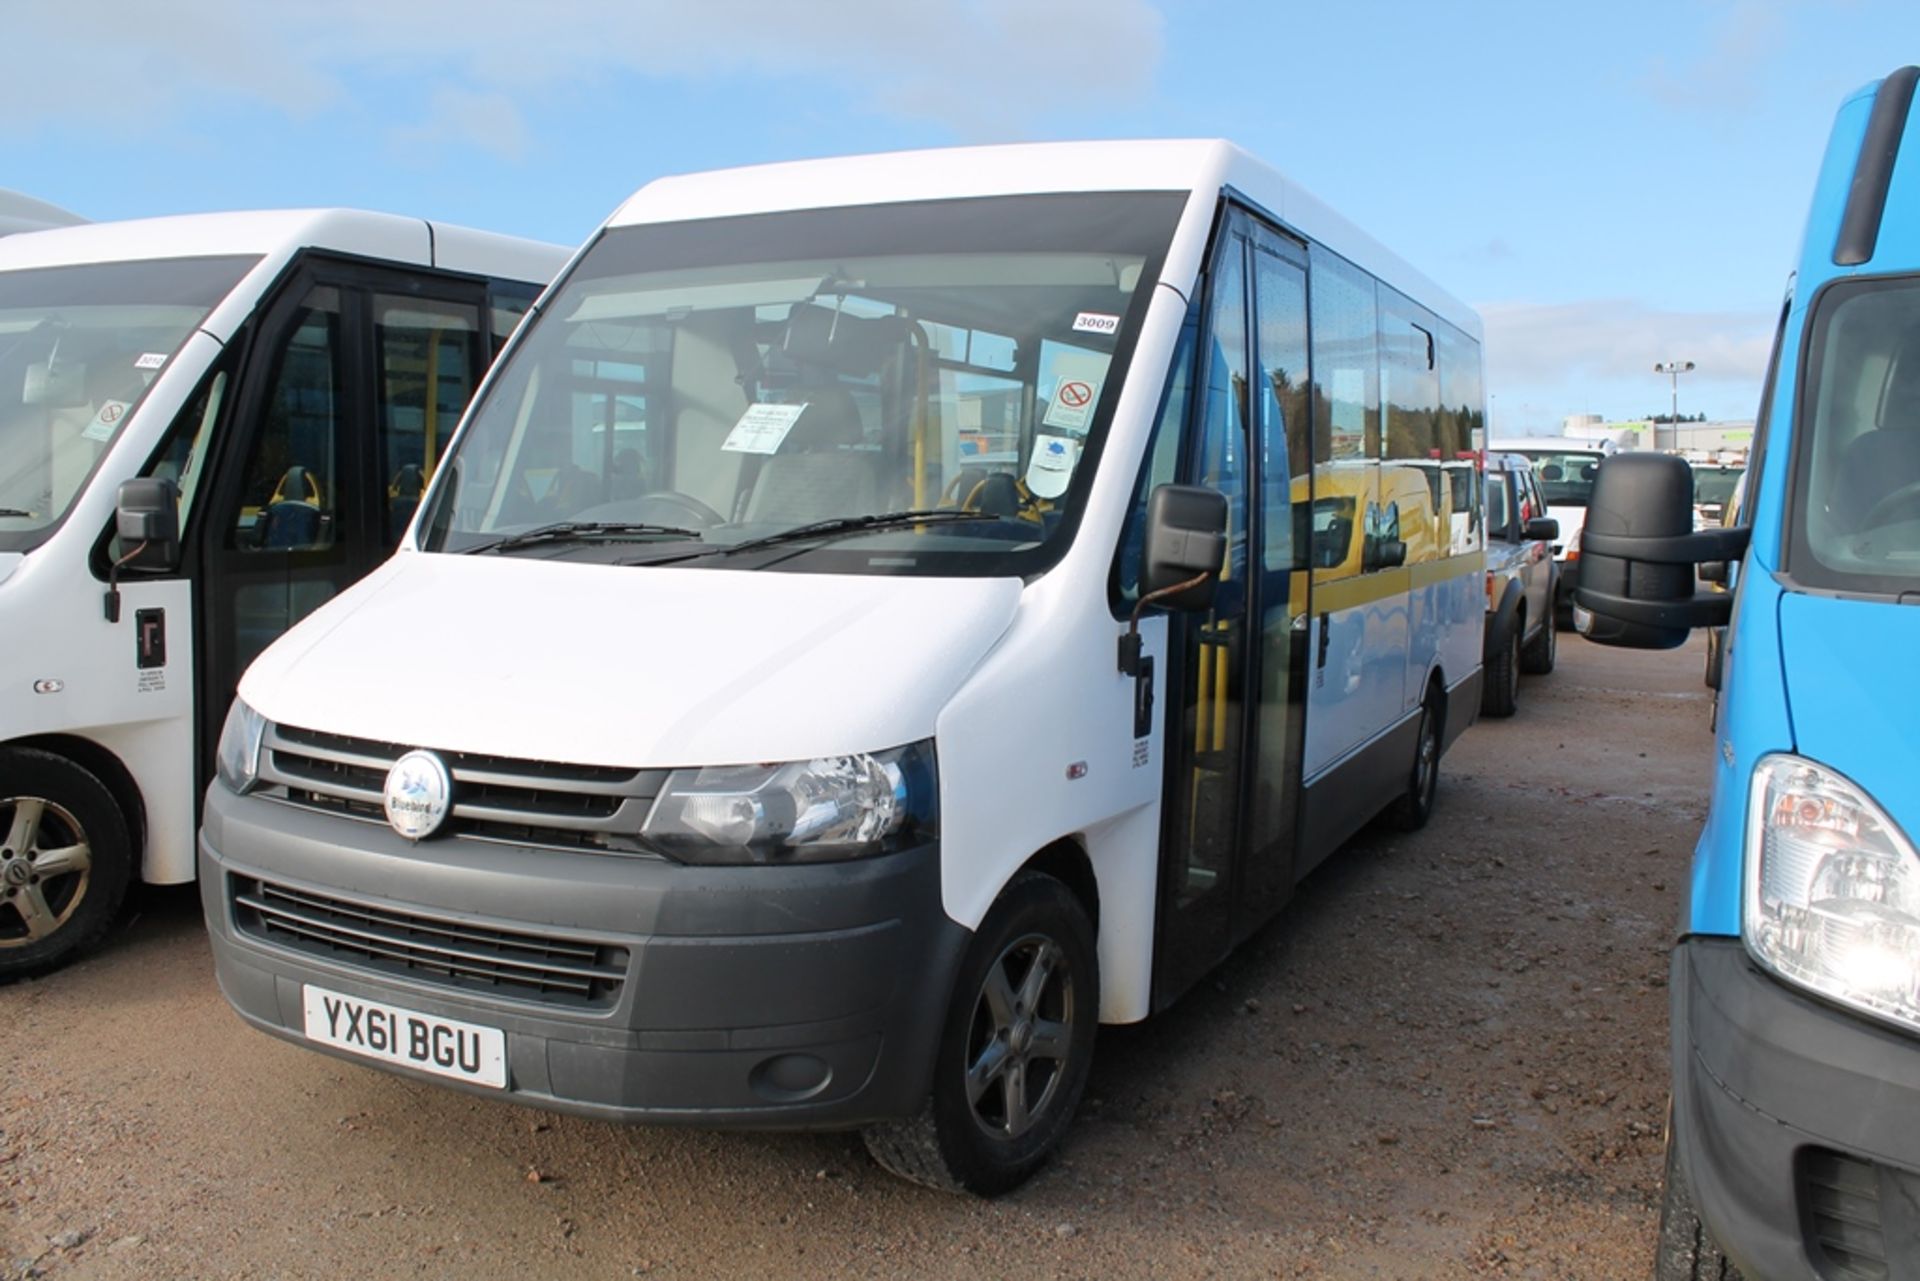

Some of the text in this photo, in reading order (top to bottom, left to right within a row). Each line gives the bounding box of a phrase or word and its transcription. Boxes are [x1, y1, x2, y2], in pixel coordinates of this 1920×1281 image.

[1078, 316, 1116, 331] 3009
[323, 995, 481, 1073] YX61 BGU
